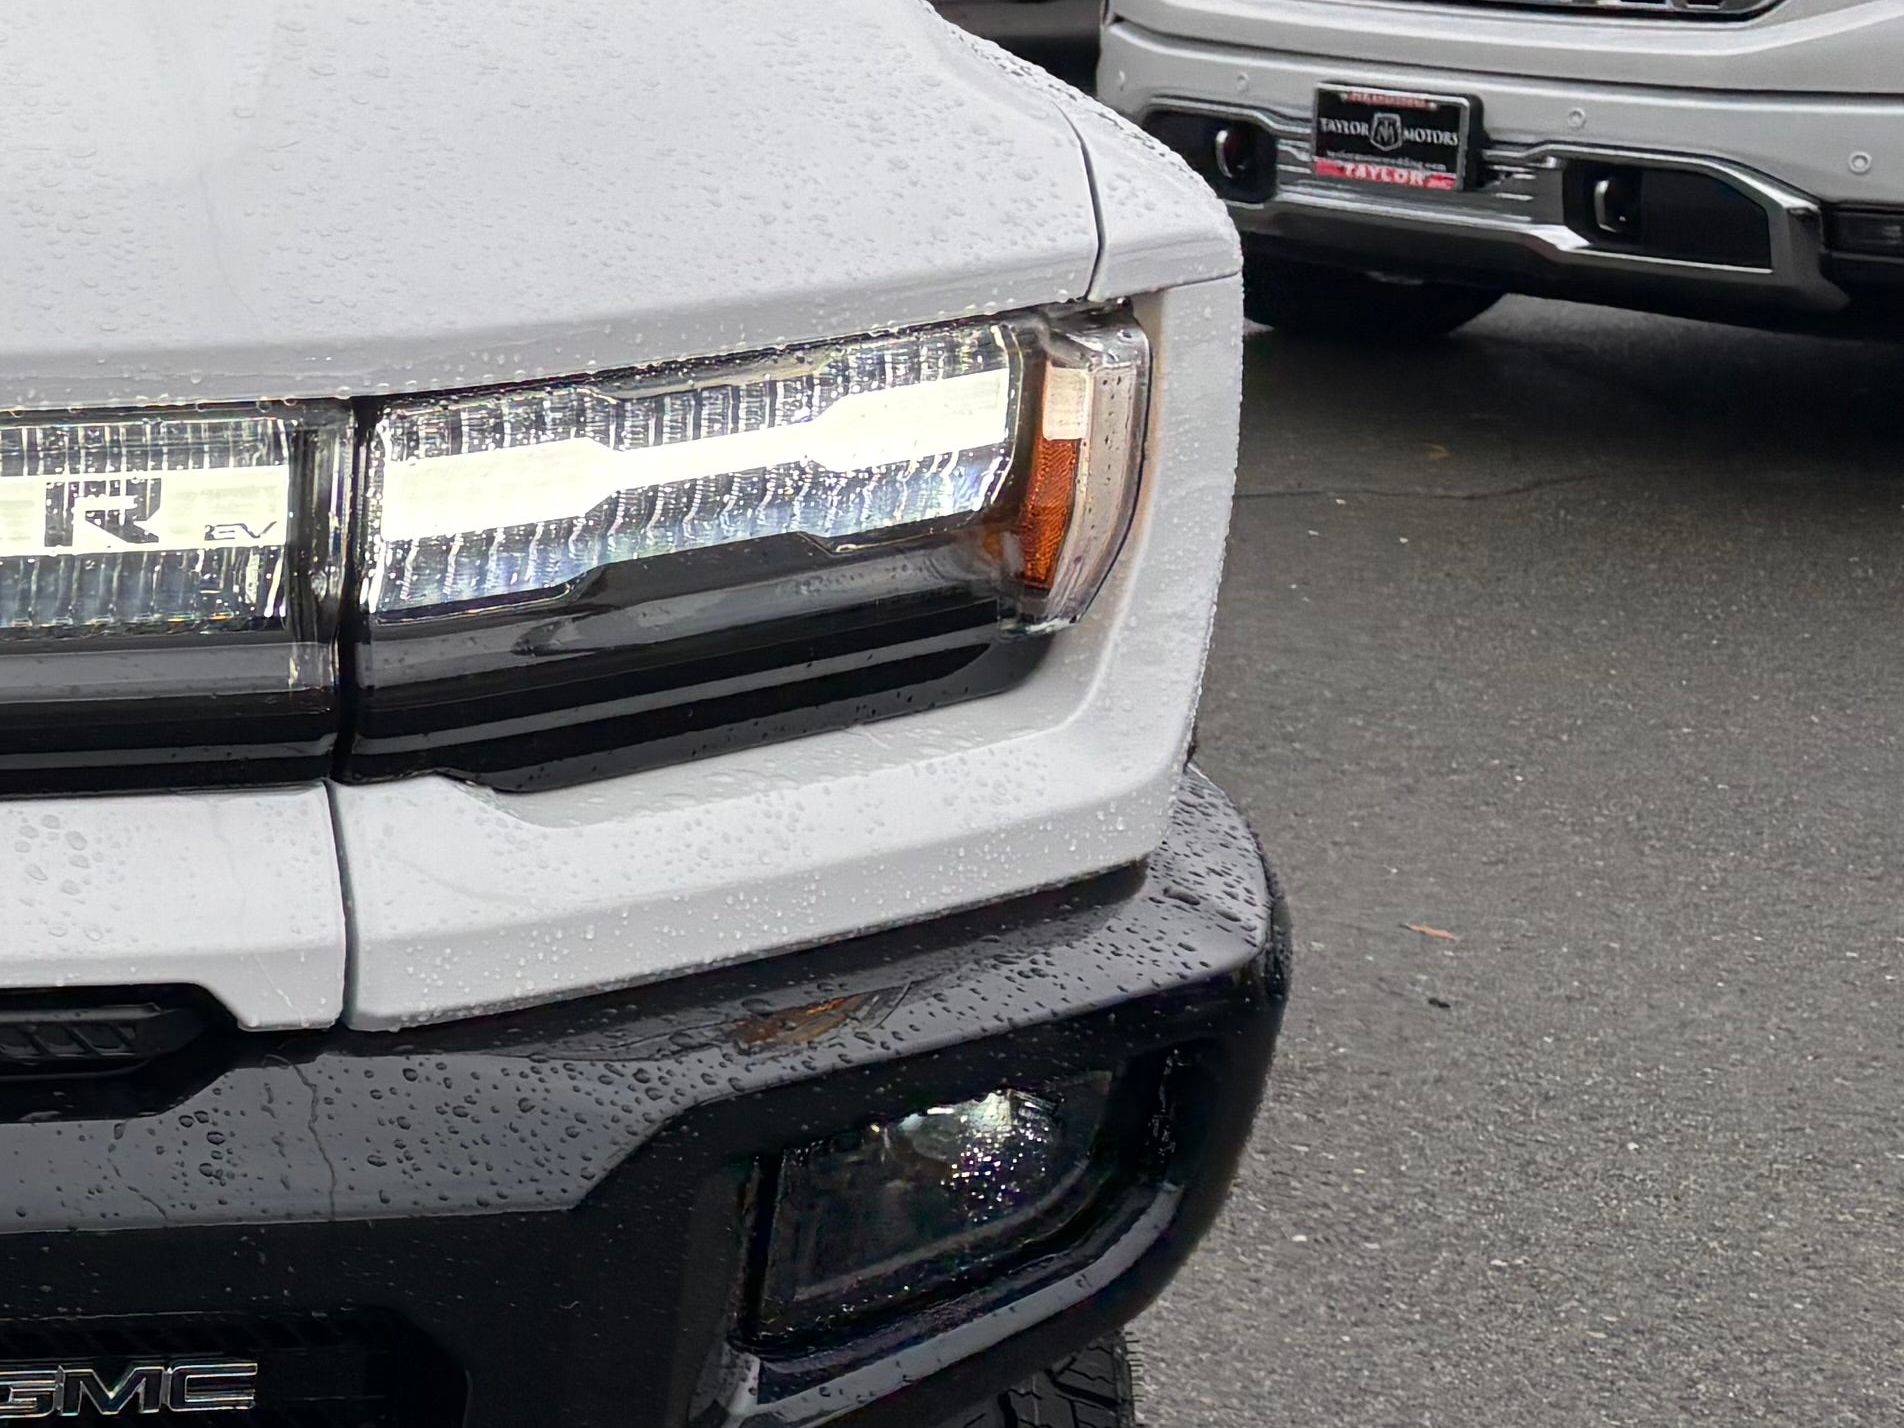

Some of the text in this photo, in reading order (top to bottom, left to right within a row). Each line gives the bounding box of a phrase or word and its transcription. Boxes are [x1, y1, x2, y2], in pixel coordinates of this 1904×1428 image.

[1319, 118, 1369, 136] TAYLOR
[1402, 126, 1458, 147] MOTORS
[1342, 163, 1424, 187] TAYLOR
[204, 521, 277, 541] EV
